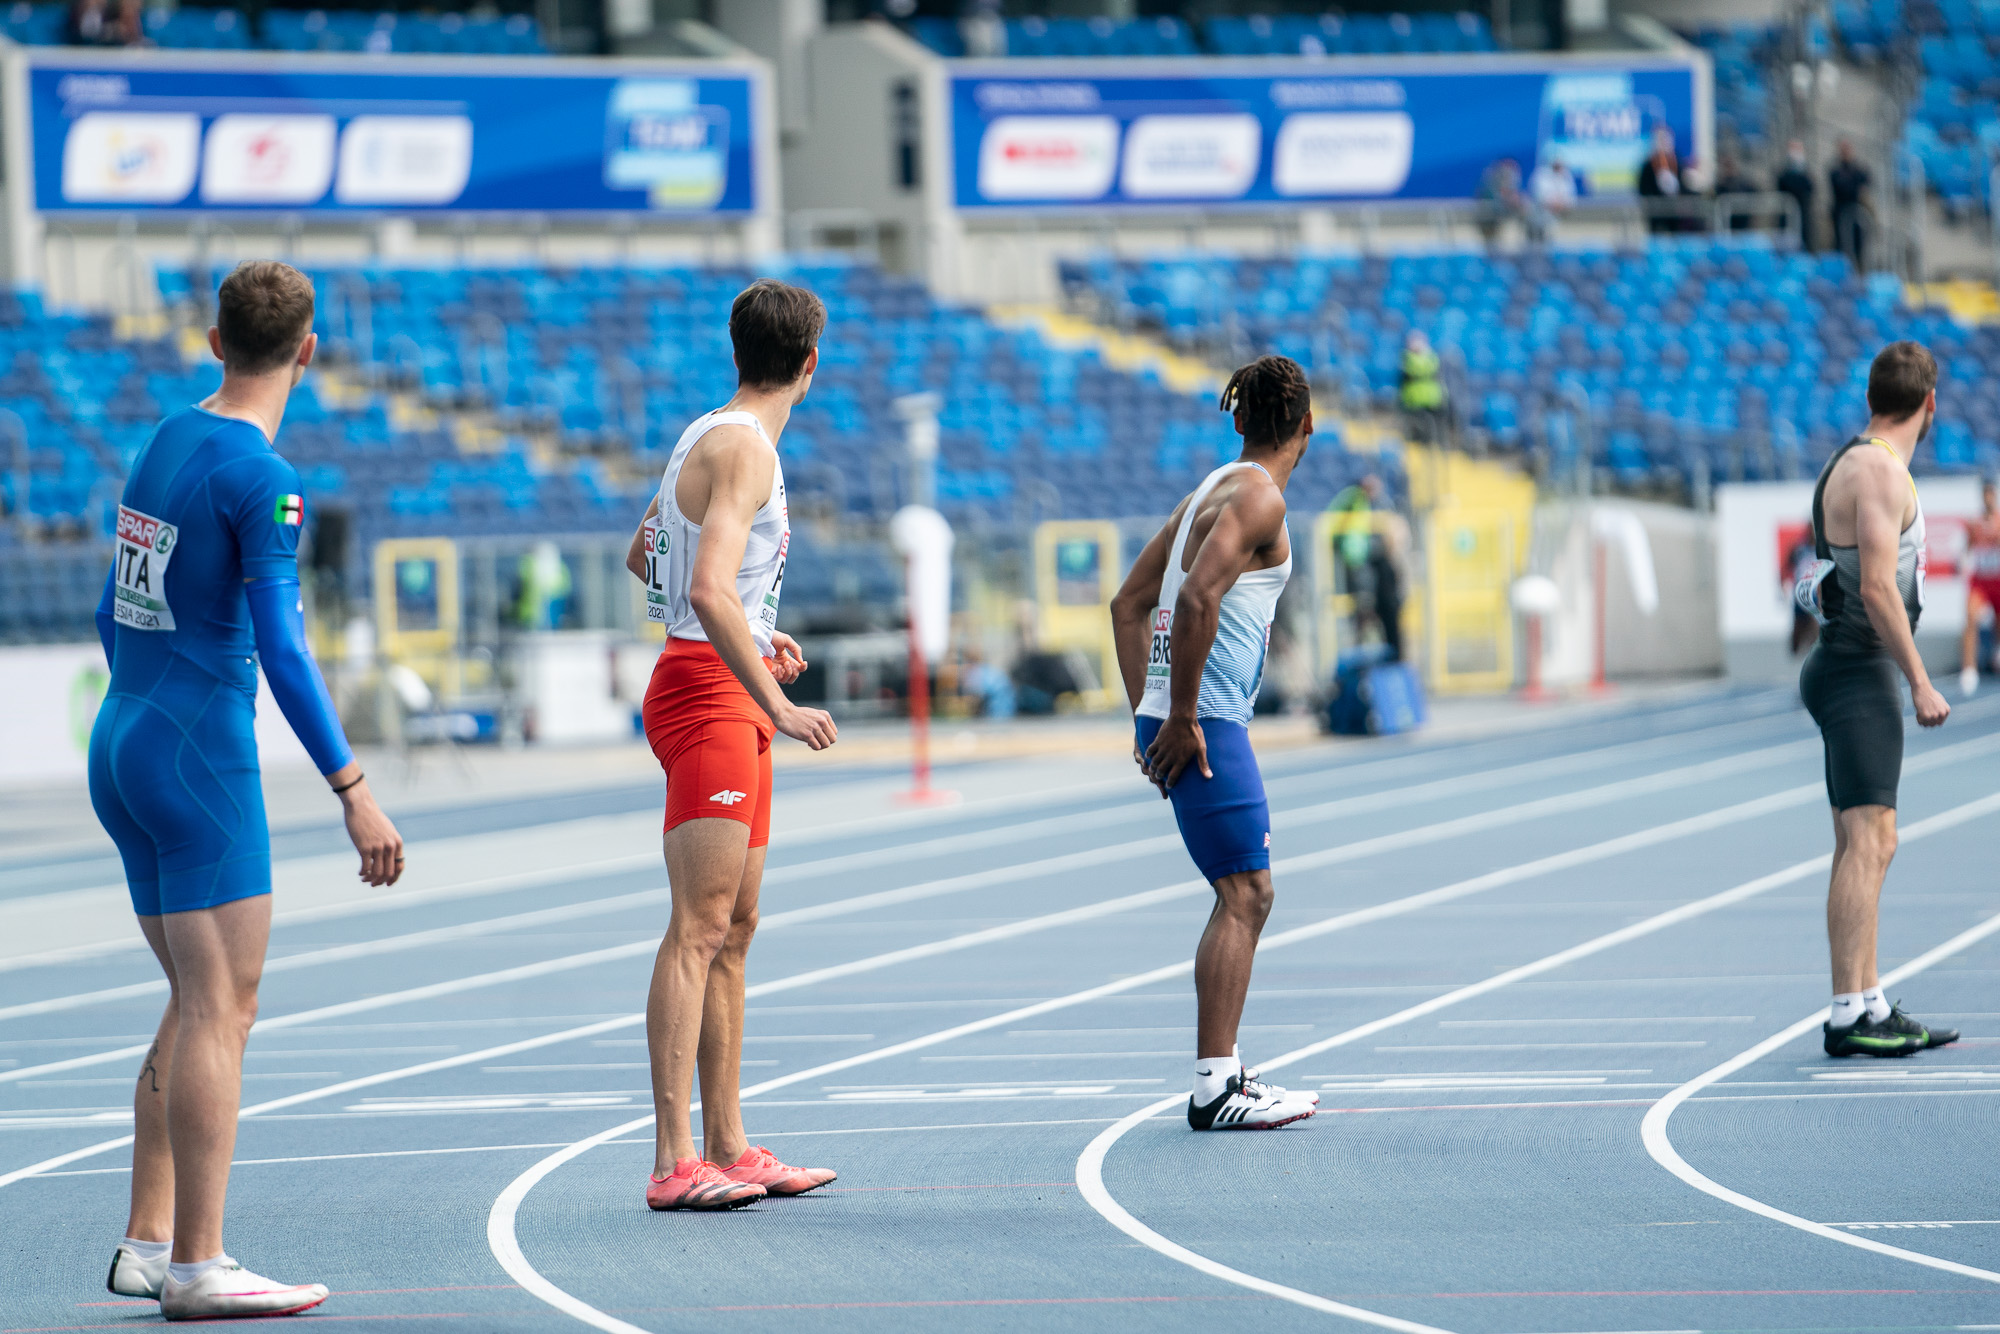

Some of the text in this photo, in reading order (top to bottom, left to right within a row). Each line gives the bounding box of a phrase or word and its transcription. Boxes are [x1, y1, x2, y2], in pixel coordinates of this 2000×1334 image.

[118, 511, 156, 545] SPAR
[118, 542, 150, 593] ITA
[135, 610, 160, 627] 2021
[648, 605, 665, 620] 2021
[709, 789, 747, 806] 4F
